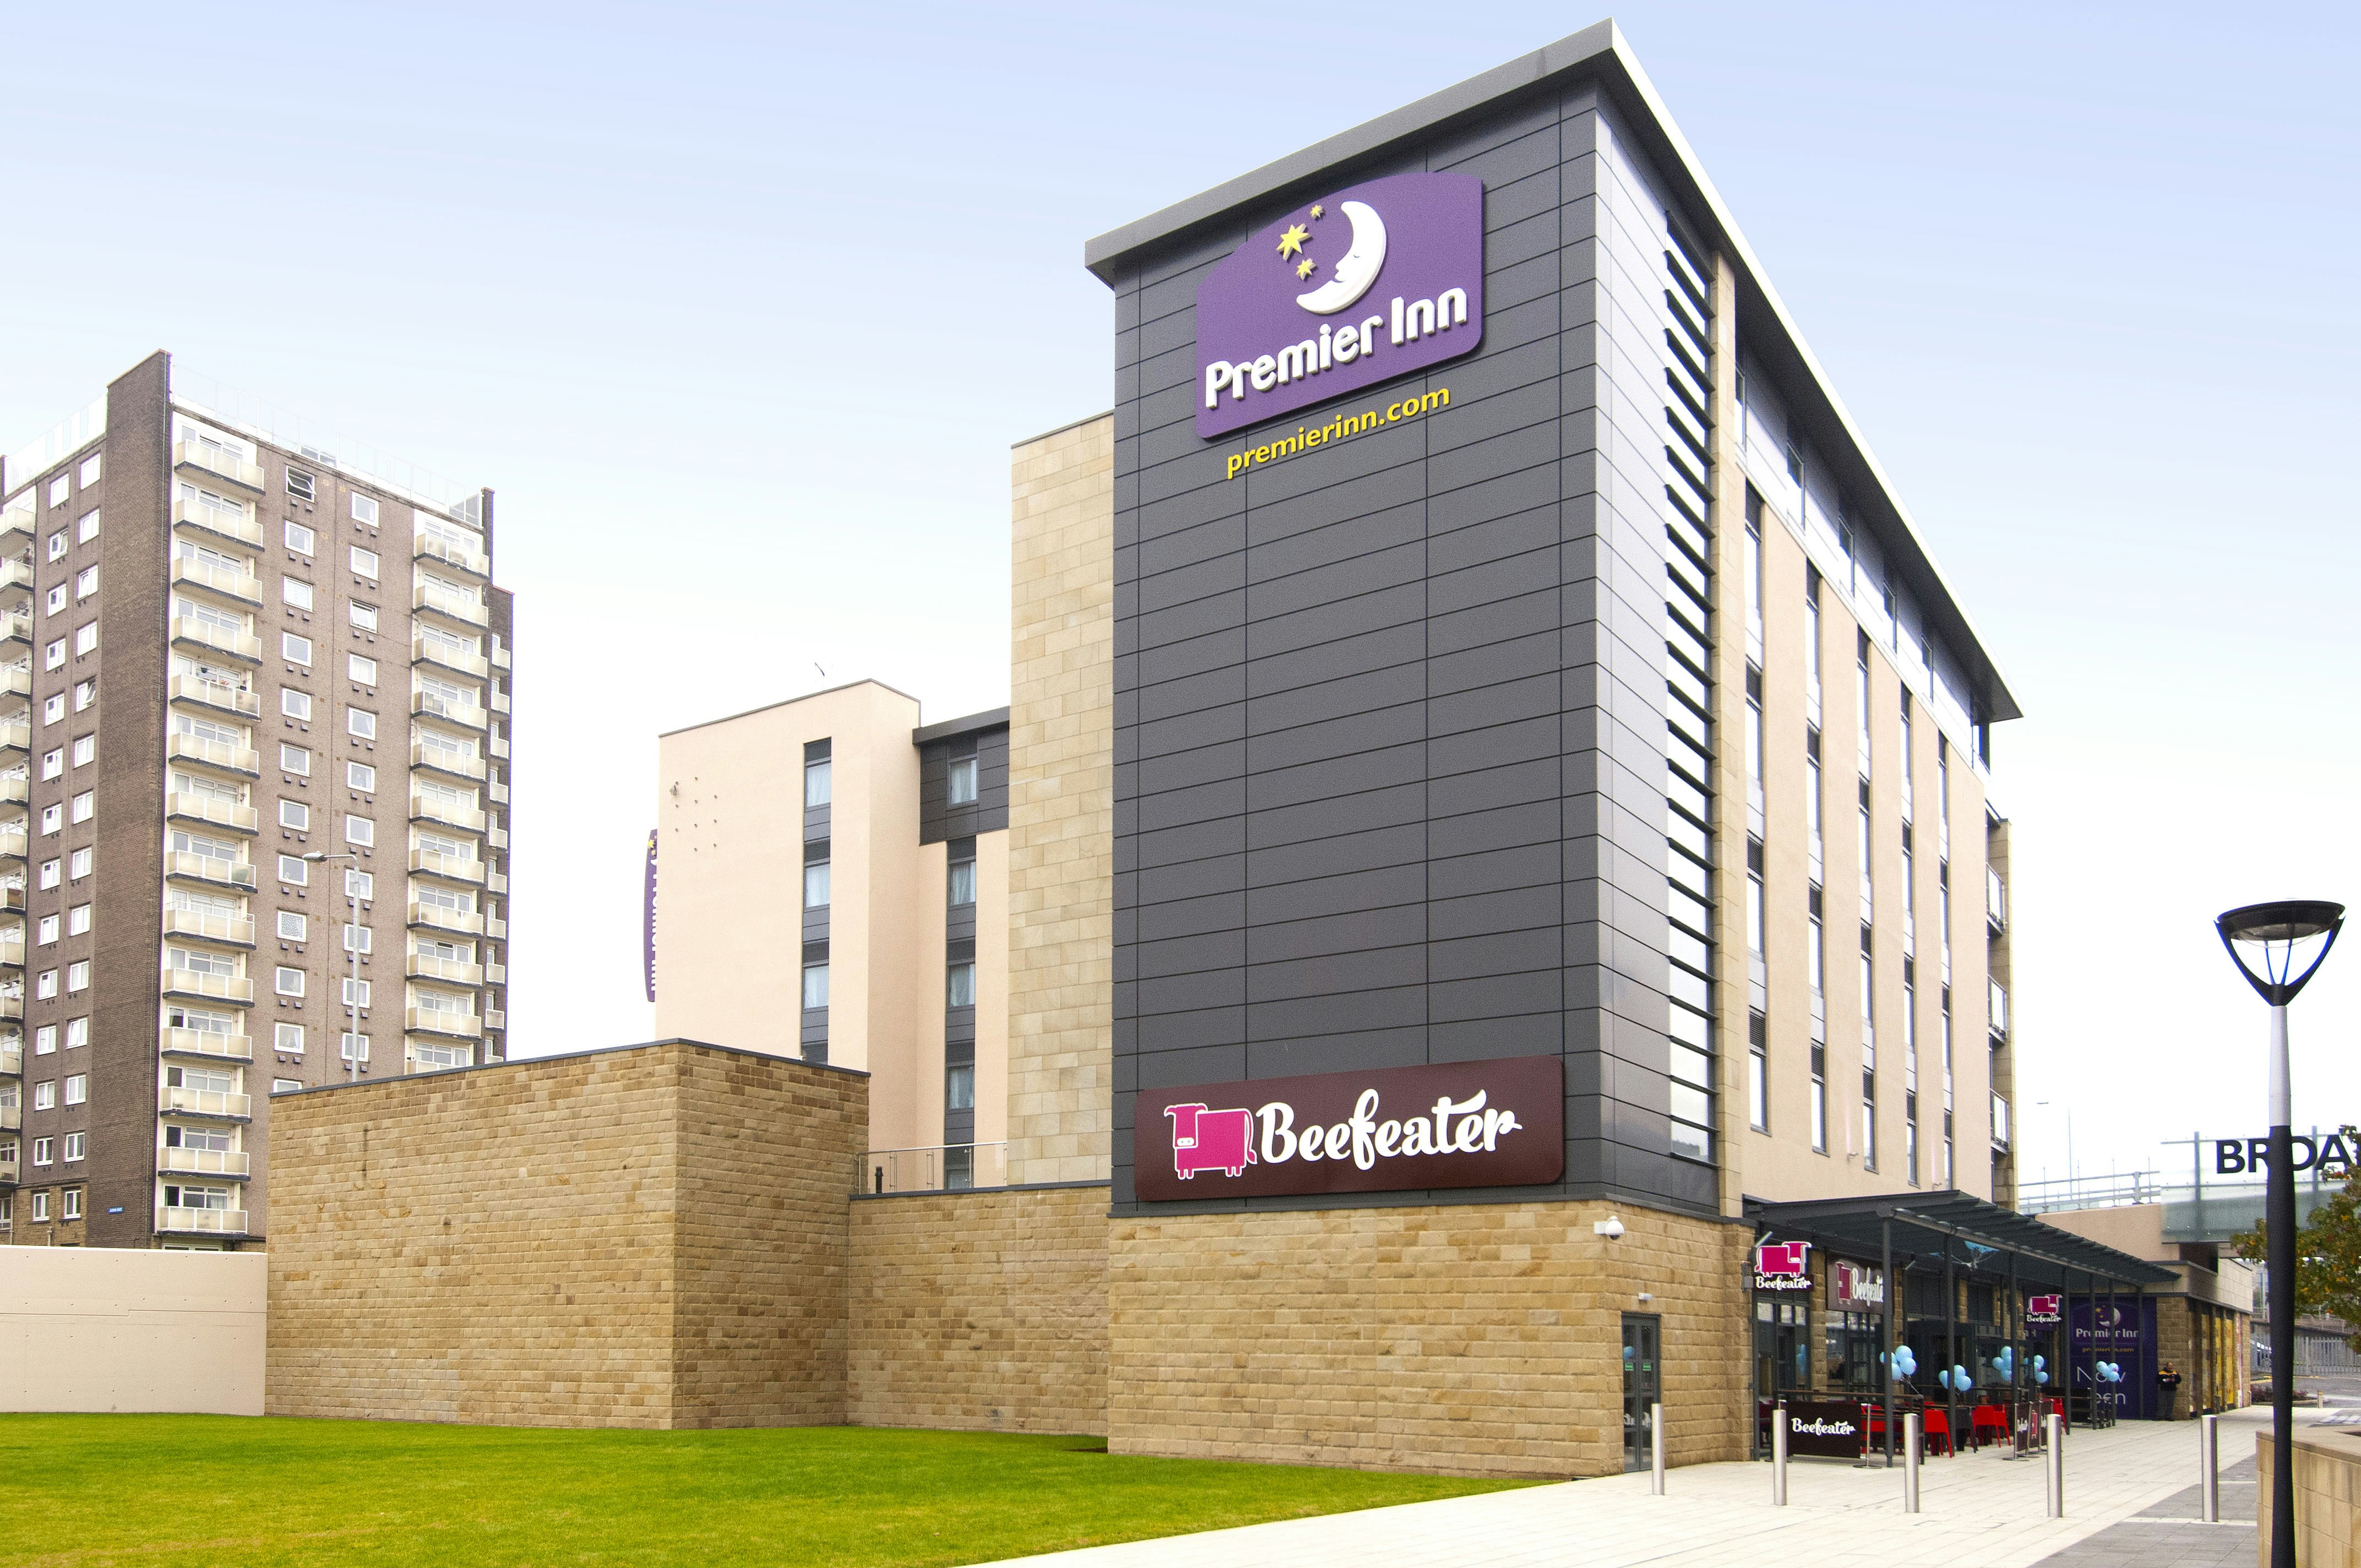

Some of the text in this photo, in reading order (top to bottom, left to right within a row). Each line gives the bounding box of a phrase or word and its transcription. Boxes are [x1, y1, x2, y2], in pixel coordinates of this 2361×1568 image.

[1205, 287, 1467, 409] Premier Inn
[1227, 388, 1450, 480] premierinn.com
[1255, 1088, 1522, 1171] Beefeater
[1755, 1275, 1813, 1291] Beefeater
[1851, 1267, 1884, 1306] Beefeate
[2026, 1314, 2062, 1323] Beefeater
[1791, 1417, 1857, 1436] Beefeater
